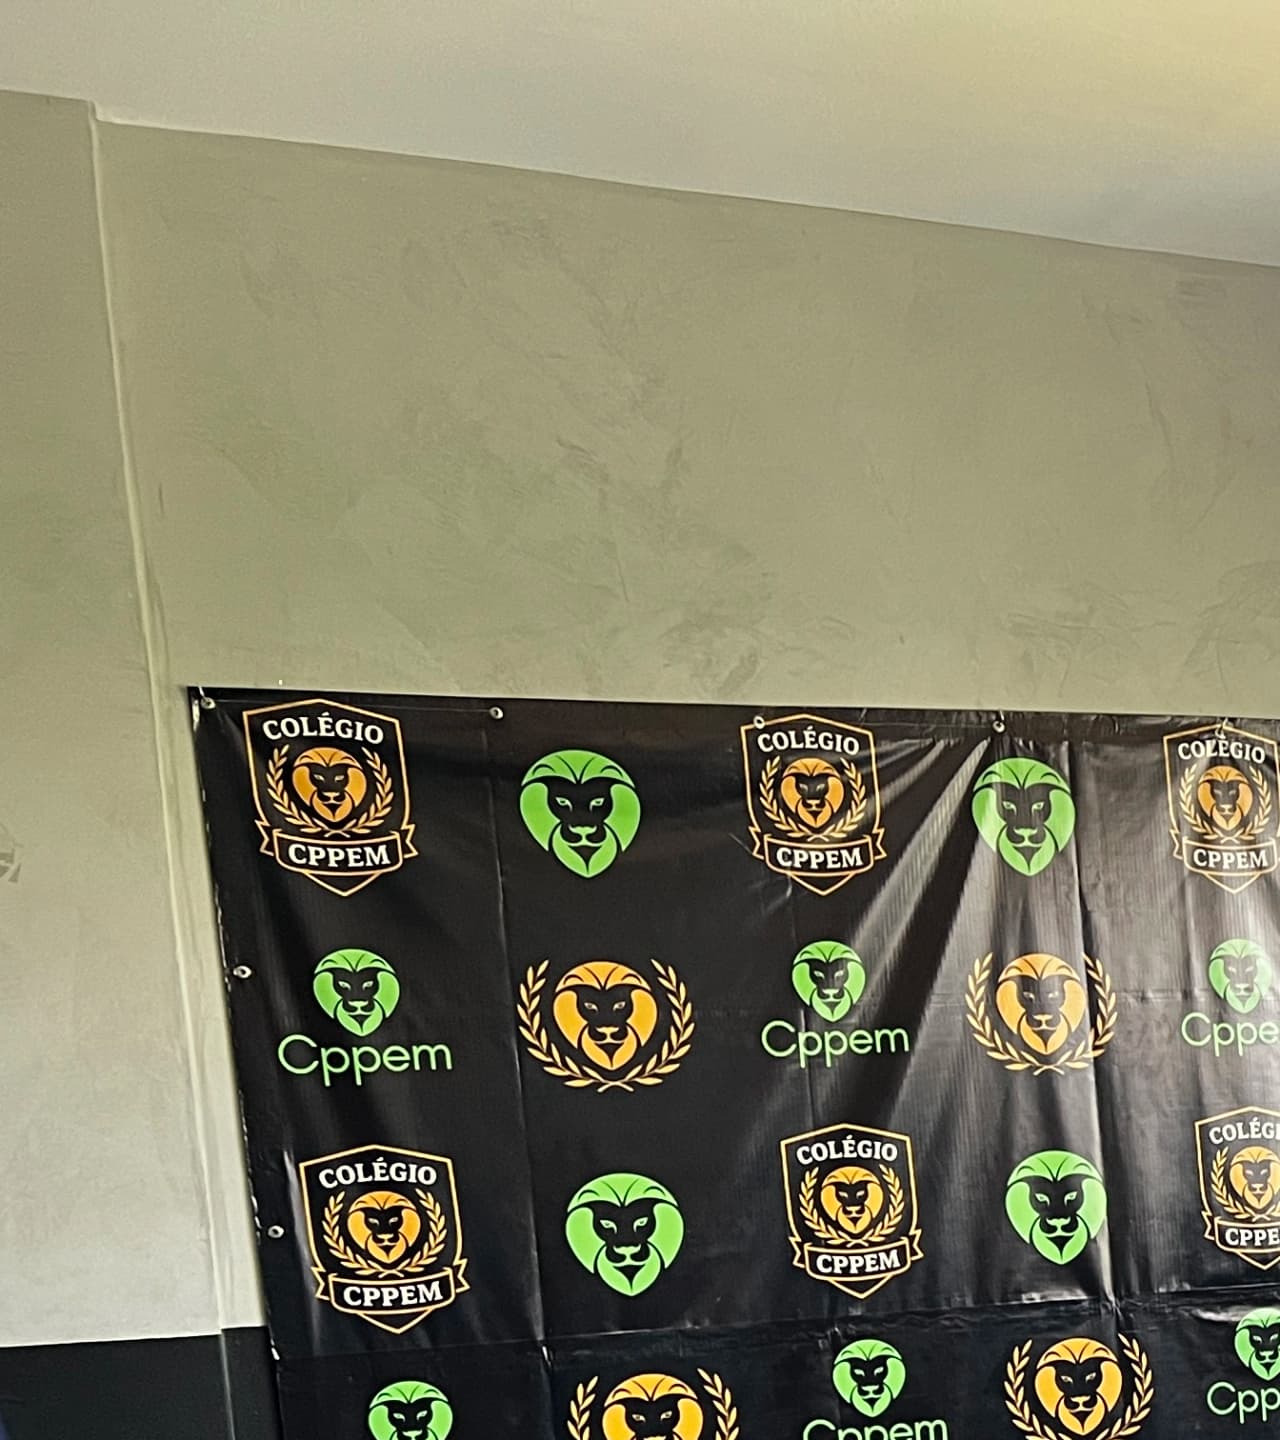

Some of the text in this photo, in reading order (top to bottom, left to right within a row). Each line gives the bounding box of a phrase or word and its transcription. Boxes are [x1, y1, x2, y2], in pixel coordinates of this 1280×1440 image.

[262, 711, 385, 745] COLÉGIO
[756, 726, 861, 755] COLÉGIO
[1177, 737, 1266, 764] COLÉGIO
[287, 842, 391, 868] CPPEM
[775, 846, 864, 870] CPPEM
[1192, 848, 1269, 869] CPPEM
[761, 1020, 909, 1067] Cppem
[277, 1034, 452, 1087] Cppem
[796, 1134, 899, 1166] COLÉGIO
[318, 1157, 438, 1189] COLÉGIO
[815, 1249, 901, 1275] CPPEM
[343, 1280, 444, 1309] CPPEM
